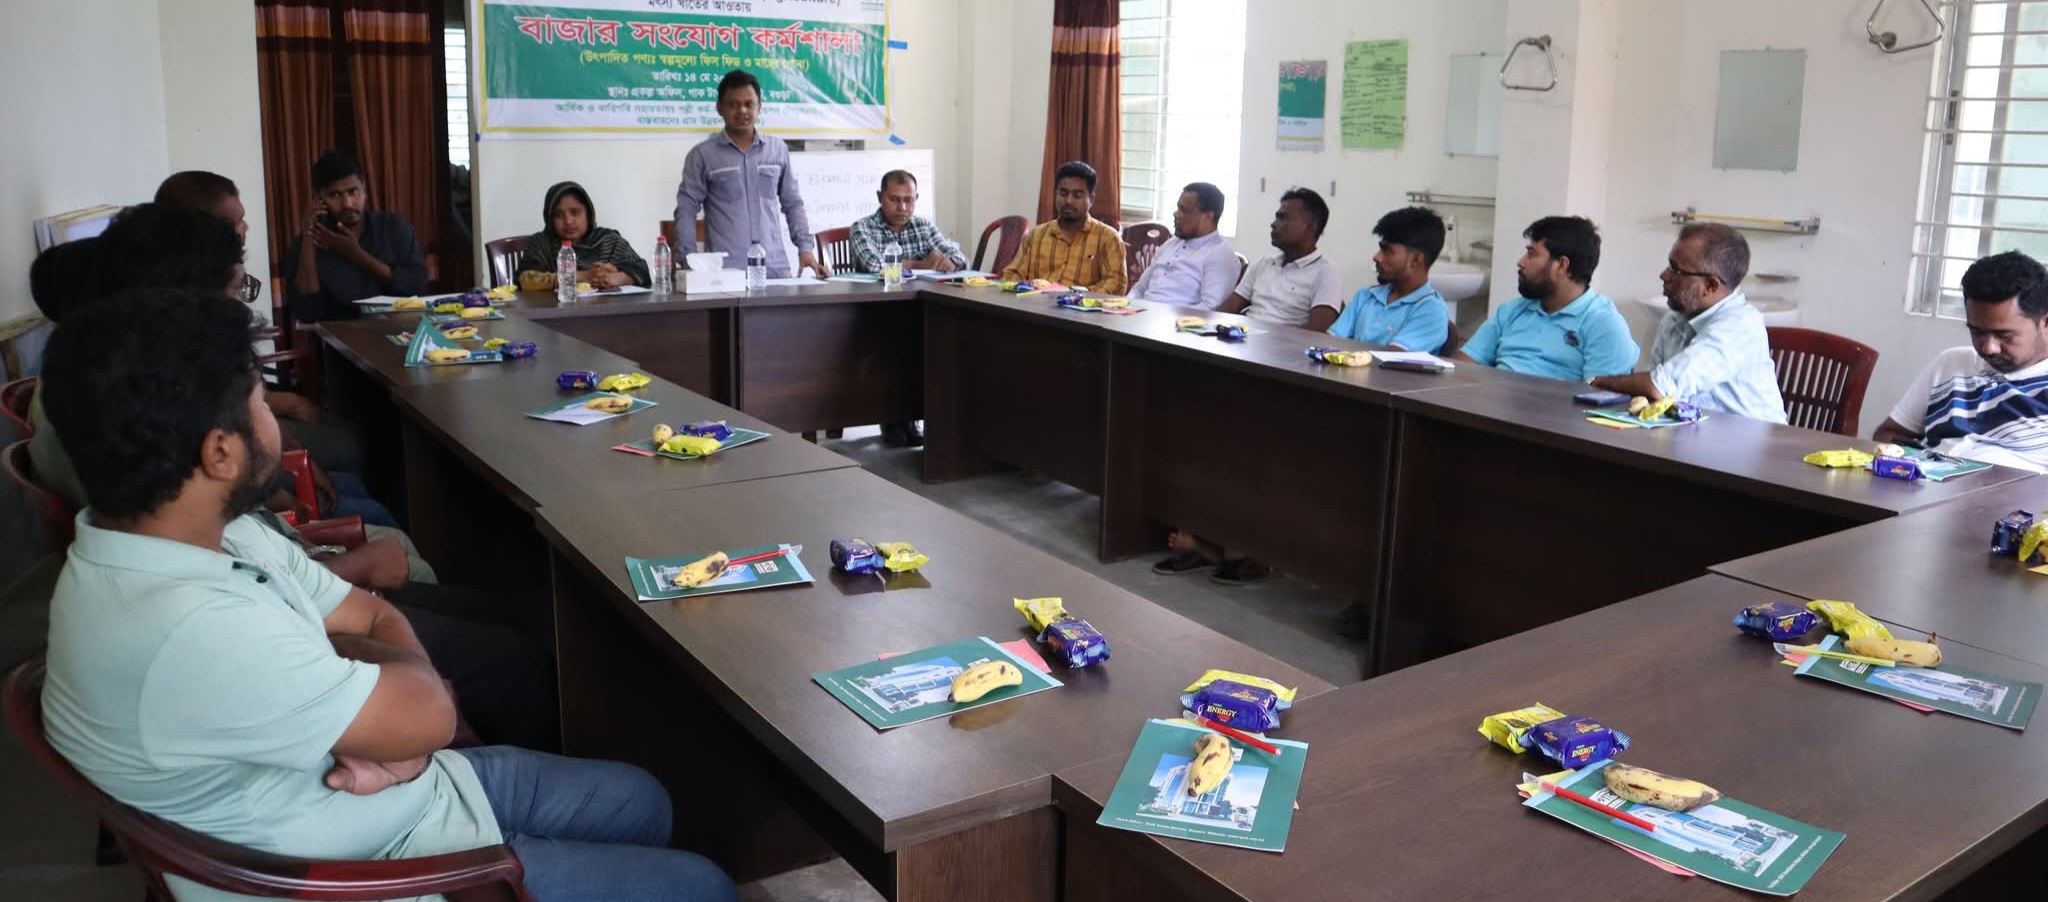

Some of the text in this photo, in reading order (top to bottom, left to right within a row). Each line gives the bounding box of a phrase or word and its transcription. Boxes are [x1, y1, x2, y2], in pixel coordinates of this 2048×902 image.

[514, 15, 864, 54] বাজার সংযোগ কর্মশালা
[744, 58, 752, 67] ও
[1207, 705, 1237, 718] ENERGY
[1571, 745, 1596, 758] ENERGY
